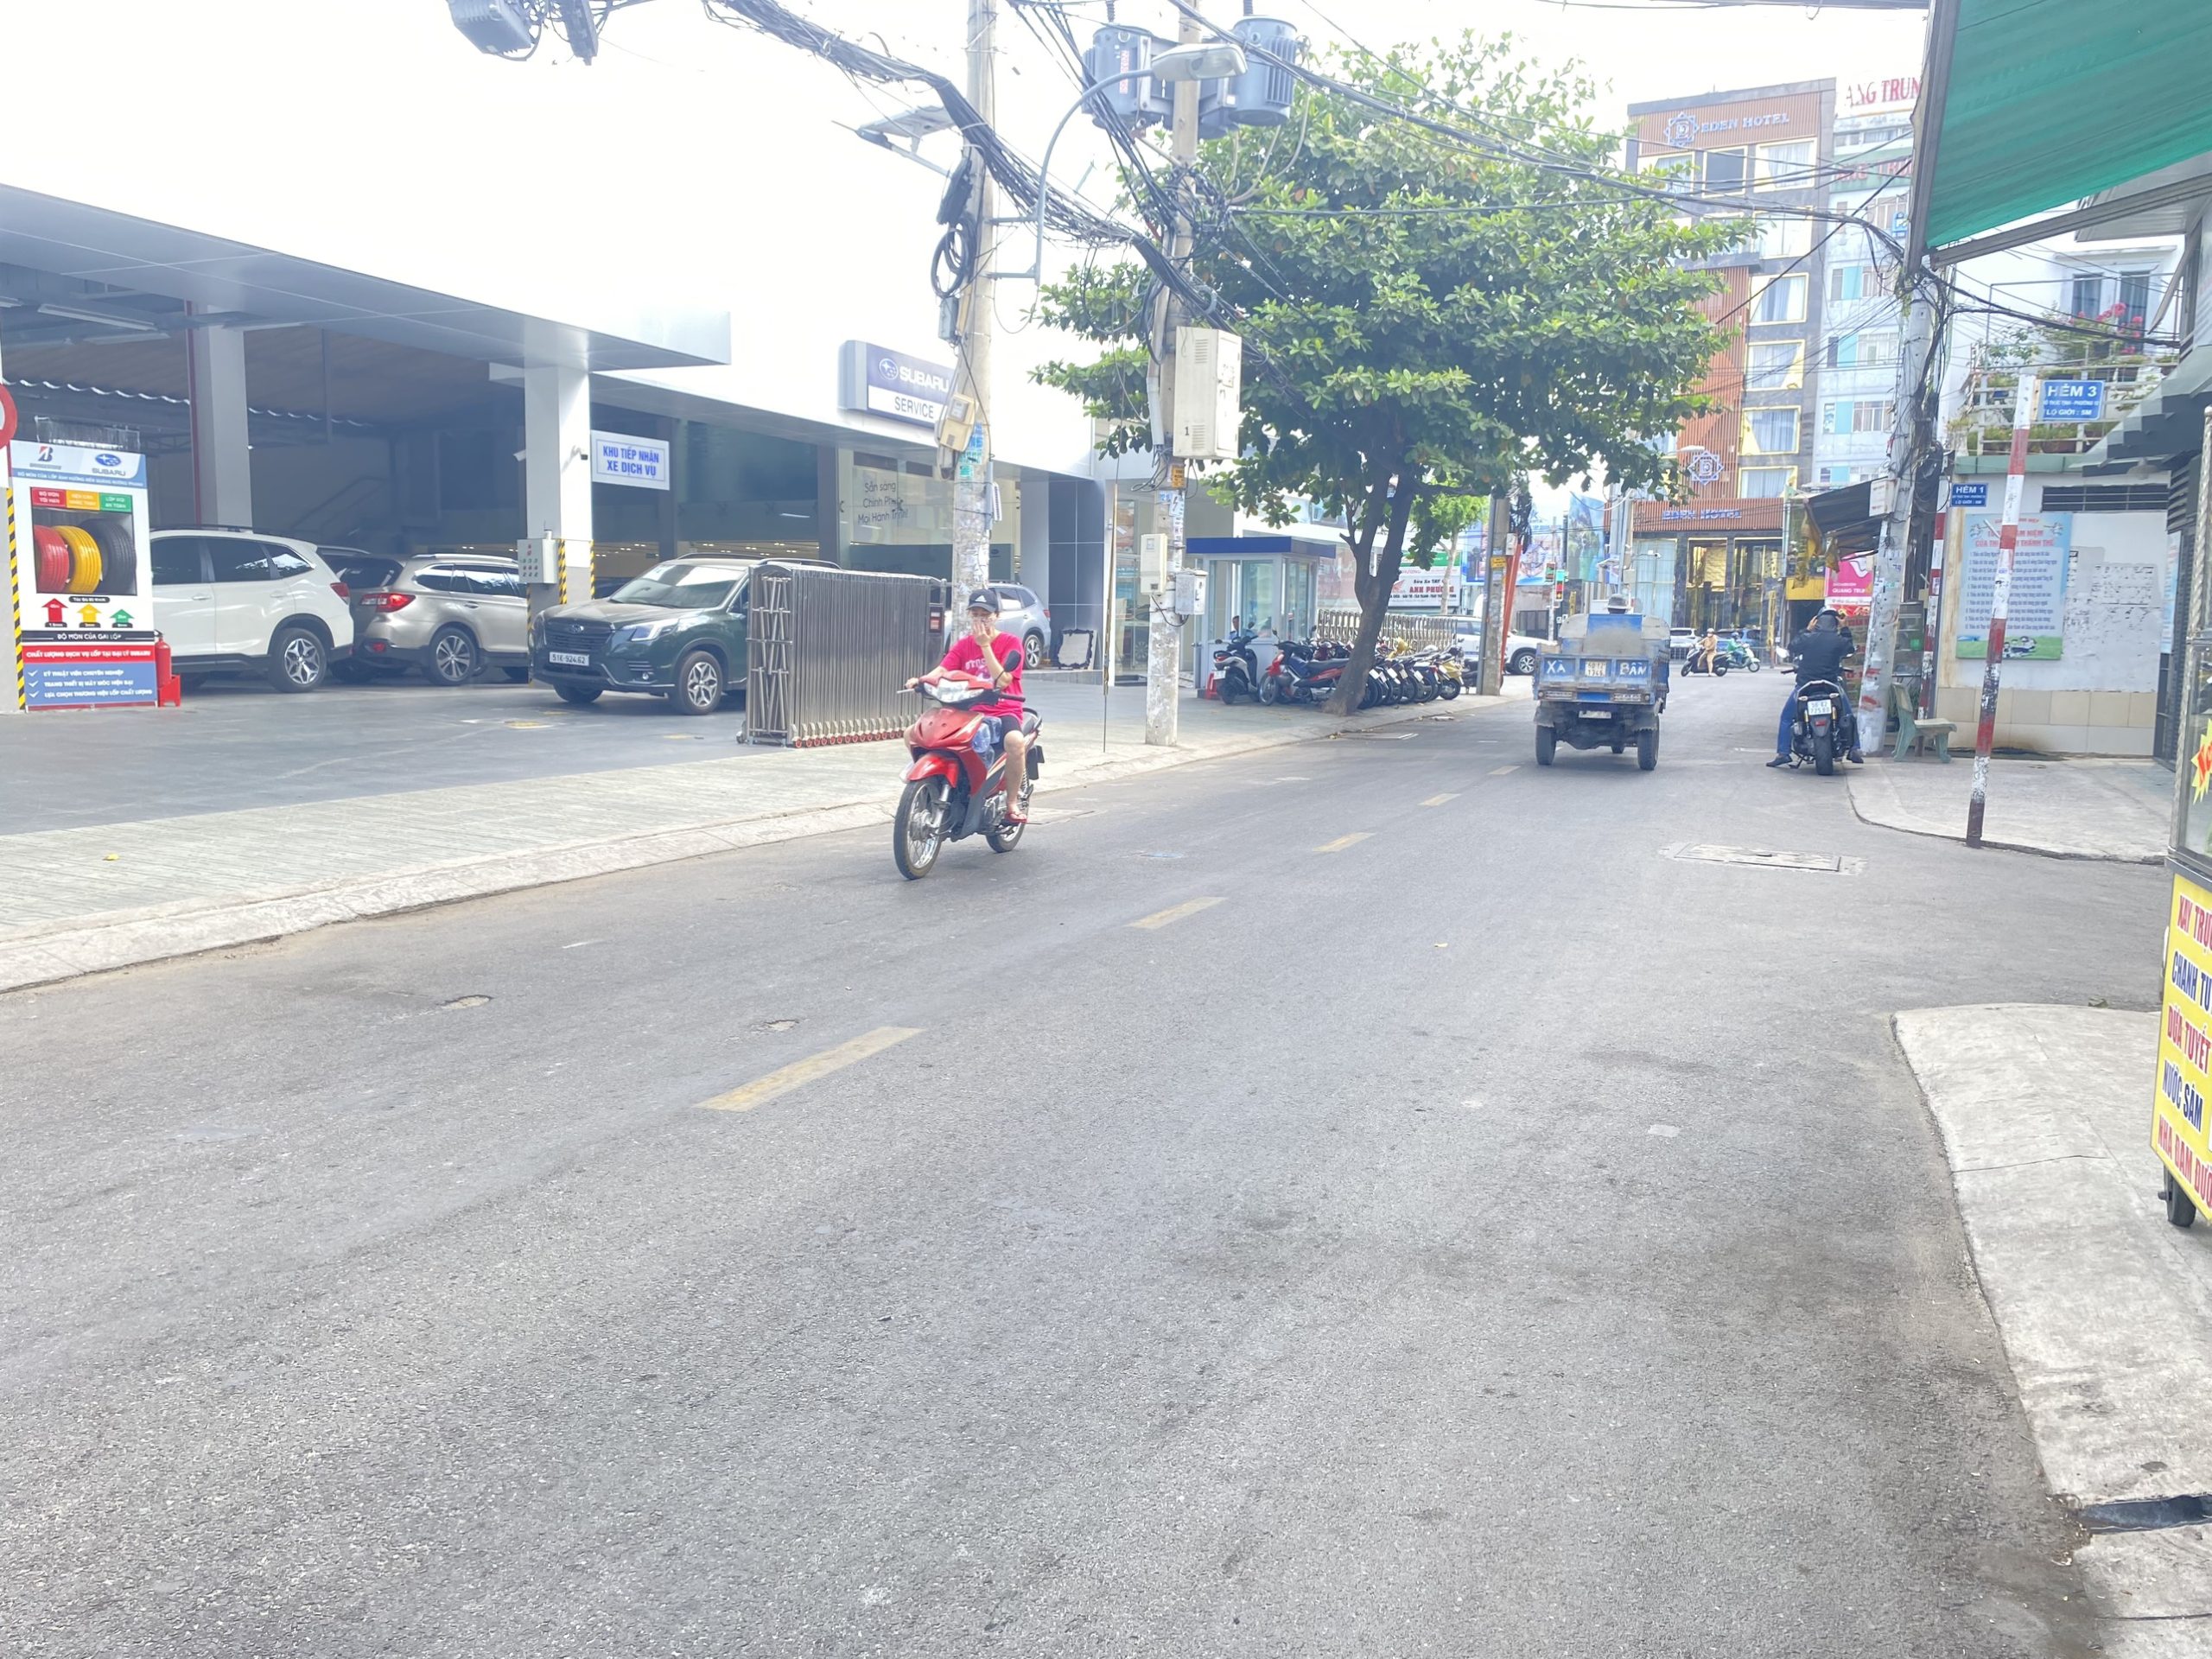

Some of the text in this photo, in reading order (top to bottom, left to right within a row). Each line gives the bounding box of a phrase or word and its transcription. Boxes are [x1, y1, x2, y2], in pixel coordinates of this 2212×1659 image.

[1701, 113, 1789, 132] EDEN HOTEL
[899, 366, 949, 391] SUBARU
[2048, 383, 2097, 397] HẺM 3
[894, 397, 934, 419] SERVICE
[603, 446, 659, 464] KHU TIẾP NHẬN
[92, 467, 126, 476] SUBARU
[607, 460, 657, 479] XE DỊCH VỤ
[2177, 895, 2193, 934] XAY
[2172, 950, 2198, 1001] CHANH
[2184, 1021, 2212, 1076] TUYẾT
[2163, 1059, 2183, 1109] NƯỚC
[2158, 1115, 2172, 1160] NHA
